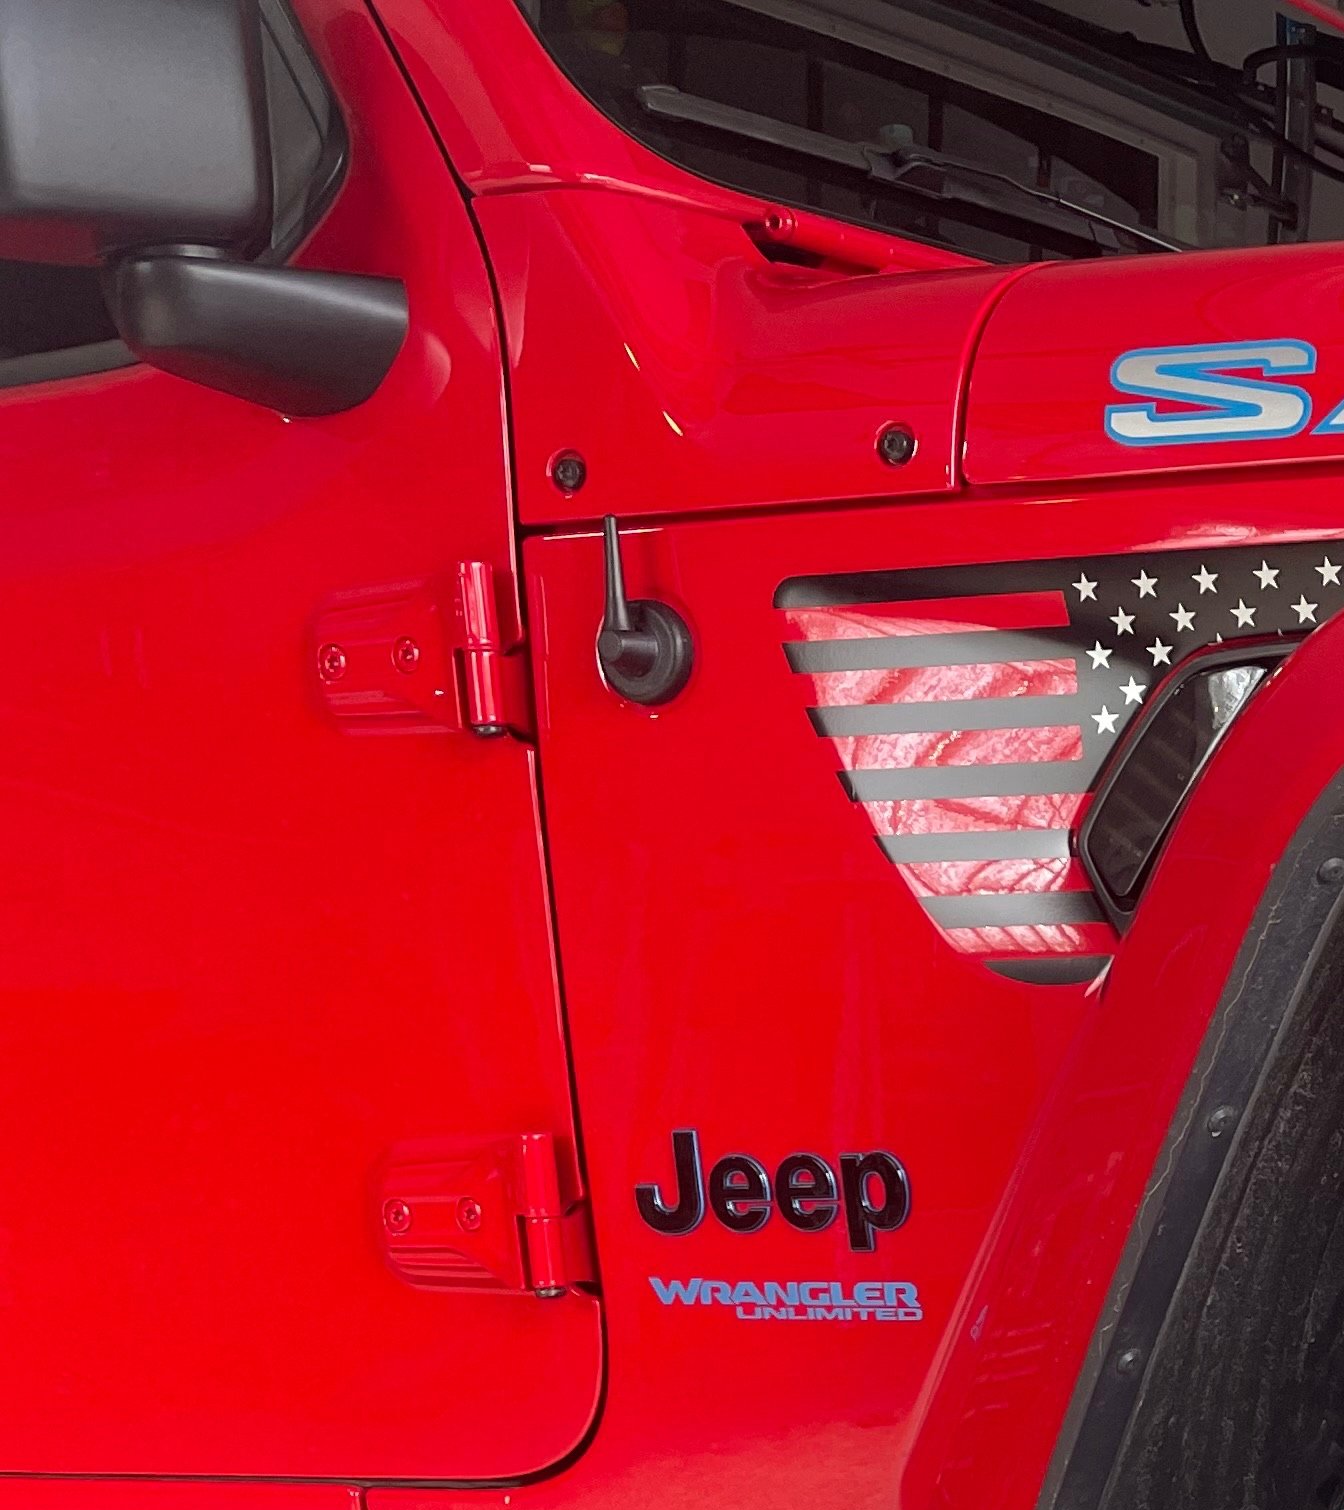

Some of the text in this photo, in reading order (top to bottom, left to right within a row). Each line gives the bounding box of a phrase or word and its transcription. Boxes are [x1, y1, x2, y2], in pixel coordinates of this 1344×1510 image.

[634, 1127, 912, 1253] Jeep
[648, 1277, 922, 1308] WRANGLER
[736, 1306, 923, 1322] UNLIMITED
